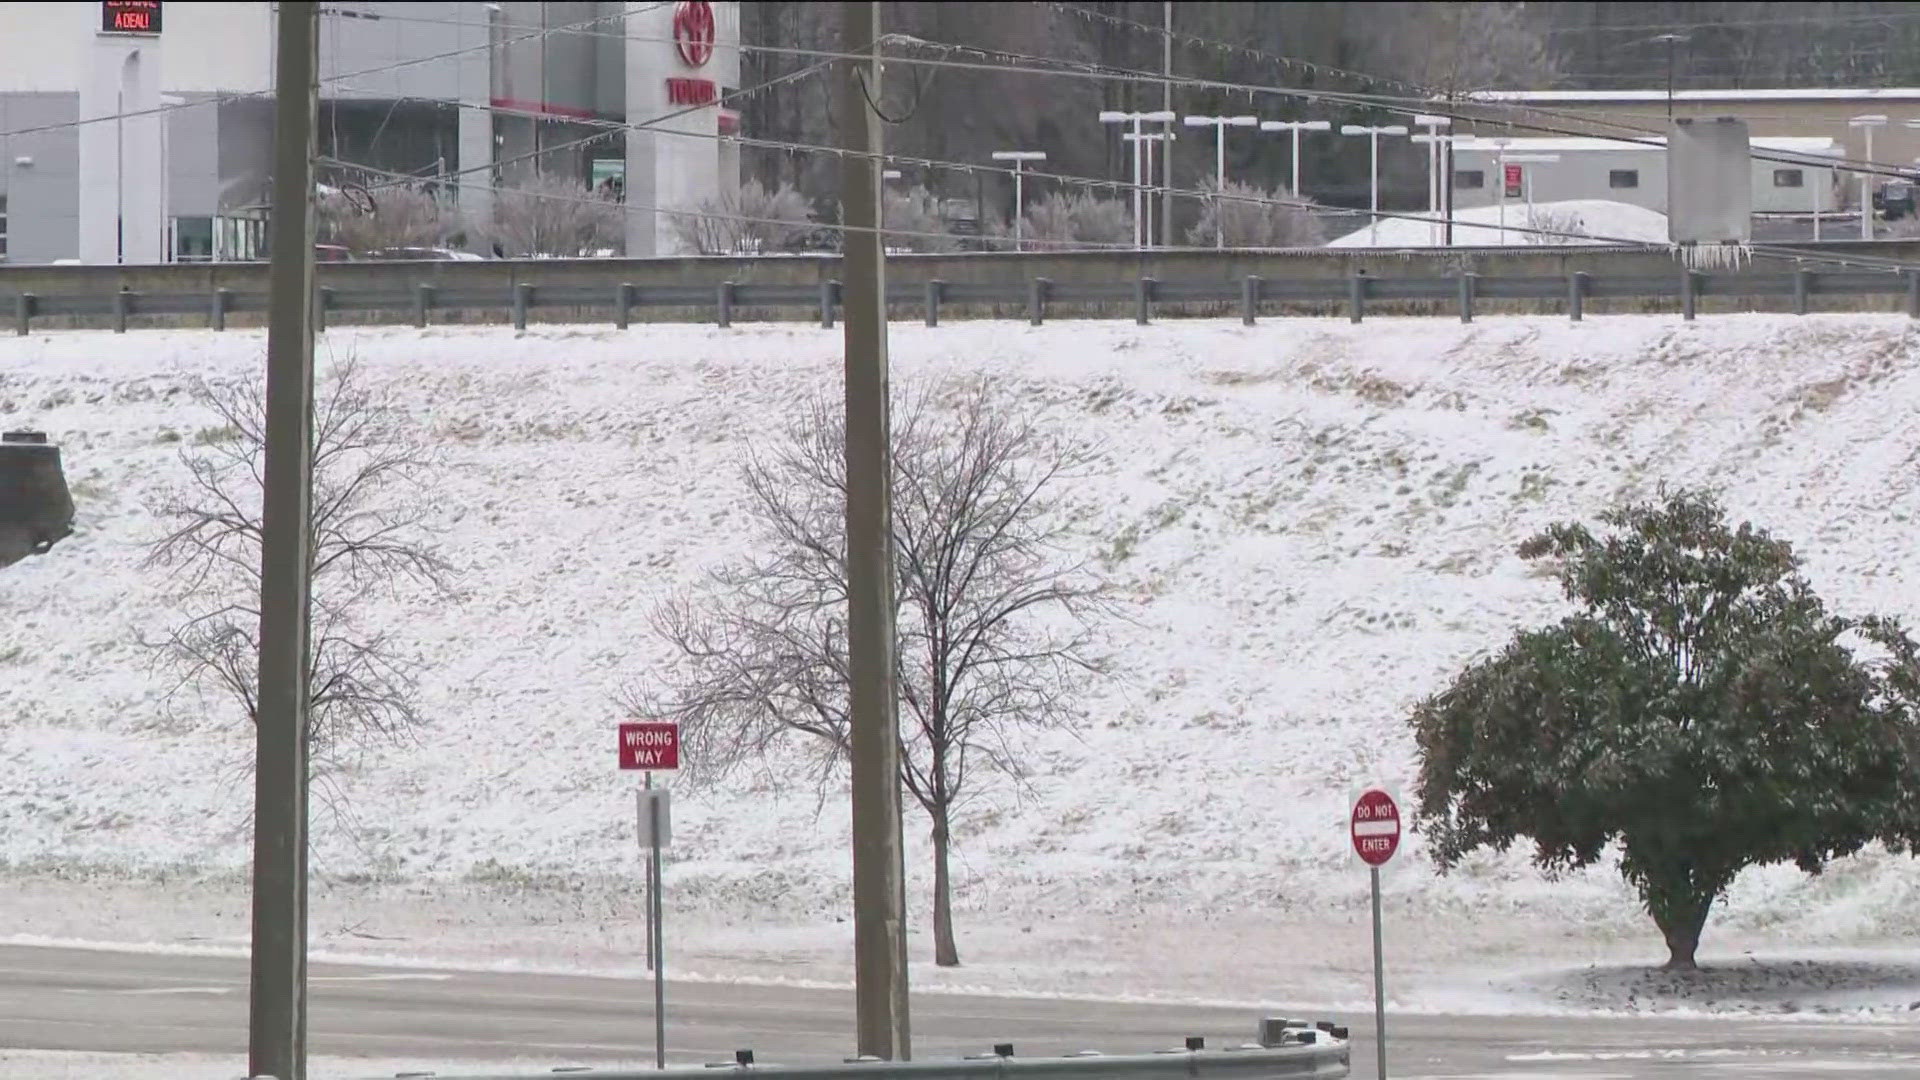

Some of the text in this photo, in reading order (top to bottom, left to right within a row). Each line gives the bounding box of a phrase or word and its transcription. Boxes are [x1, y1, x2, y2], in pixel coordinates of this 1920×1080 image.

[115, 12, 122, 28] A
[625, 731, 672, 746] WRONG
[634, 750, 663, 764] WAY
[1357, 804, 1392, 818] DO NOT
[1362, 838, 1390, 852] ENTER
